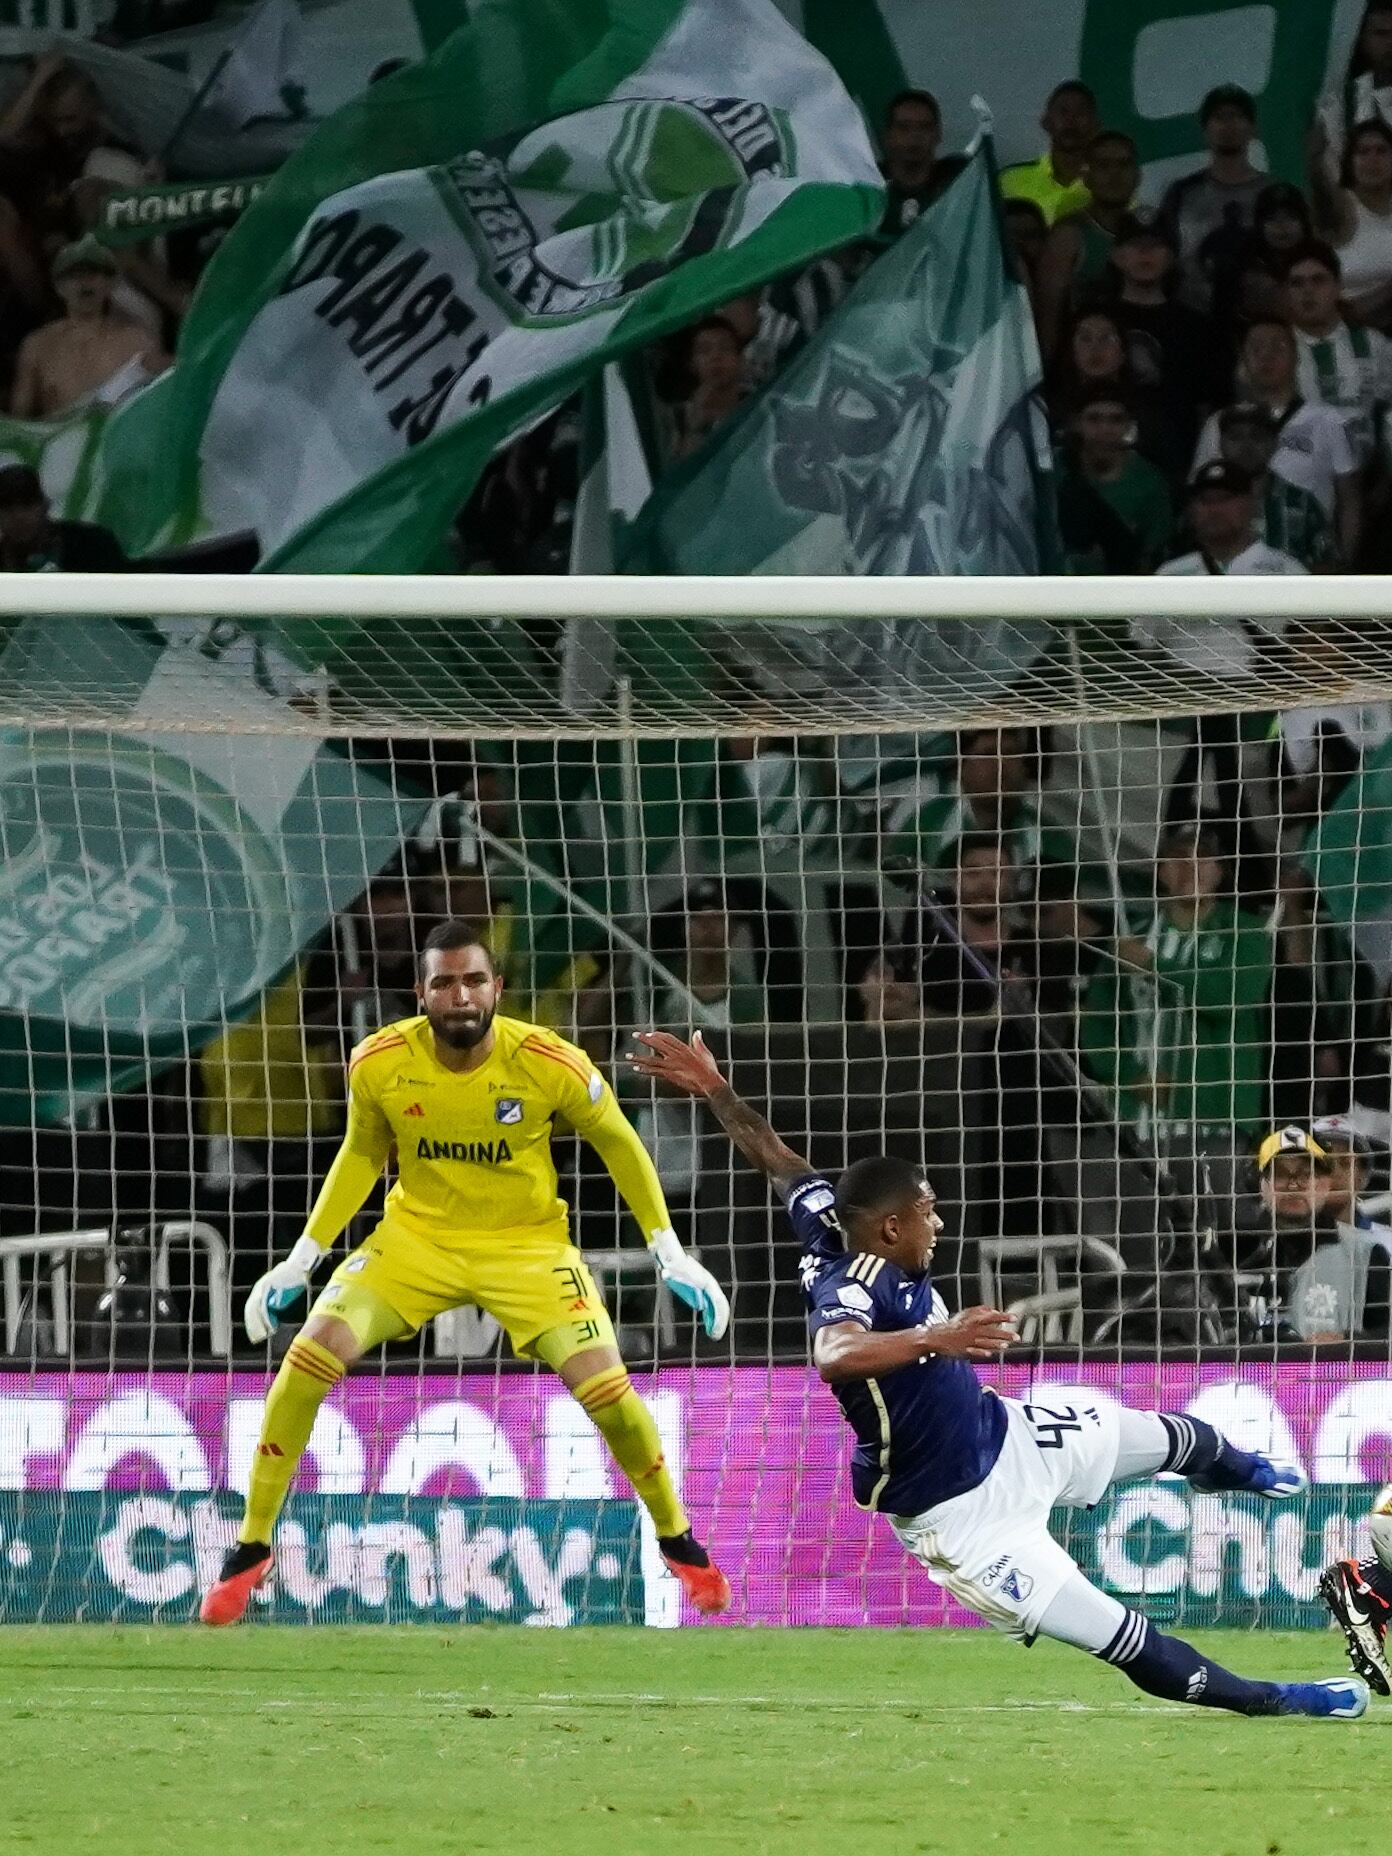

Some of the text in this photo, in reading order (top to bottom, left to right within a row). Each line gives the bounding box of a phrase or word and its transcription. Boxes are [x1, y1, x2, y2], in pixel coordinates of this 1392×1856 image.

[417, 1136, 513, 1164] ANDINA
[552, 1267, 588, 1300] 31
[572, 1319, 600, 1343] 31
[1023, 1404, 1082, 1449] 42
